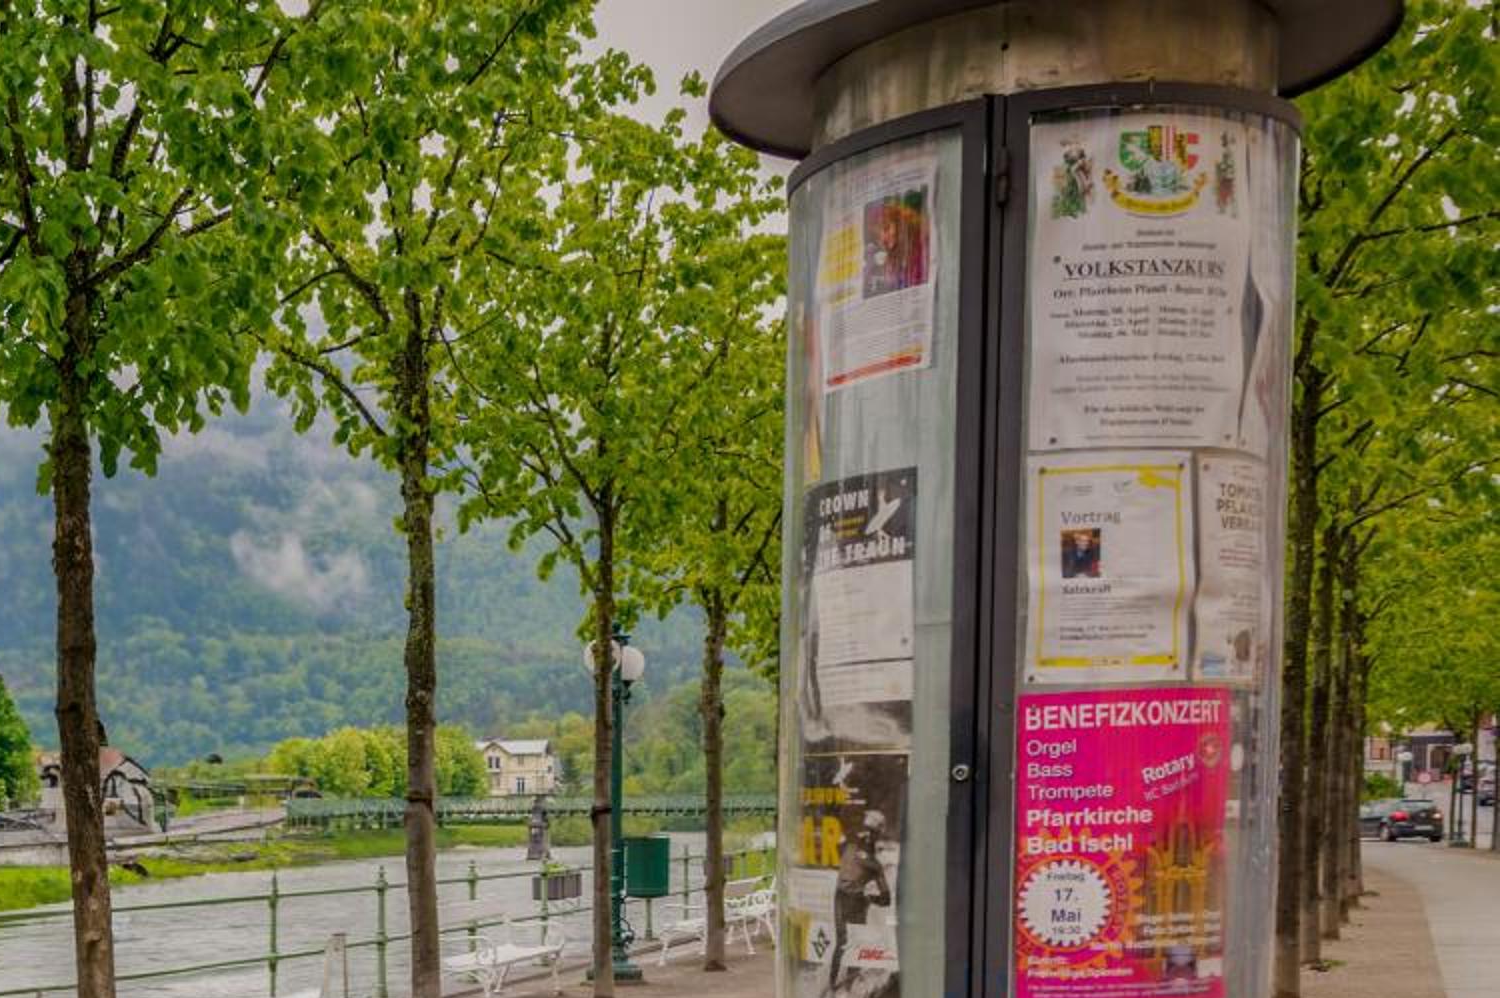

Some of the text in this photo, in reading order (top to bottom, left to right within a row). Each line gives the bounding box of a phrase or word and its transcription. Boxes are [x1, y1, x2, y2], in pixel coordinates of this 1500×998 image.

[819, 489, 869, 516] CROWN
[1025, 700, 1222, 731] BENEFIZKONZERT
[1026, 739, 1078, 759] Orgel
[1026, 763, 1073, 778] Bass
[1141, 752, 1196, 784] Rotary
[1028, 783, 1115, 801] Trompete
[1026, 806, 1154, 827] Pfarrkirche
[1026, 833, 1134, 855] Bad Ischl
[1051, 908, 1081, 923] Mai
